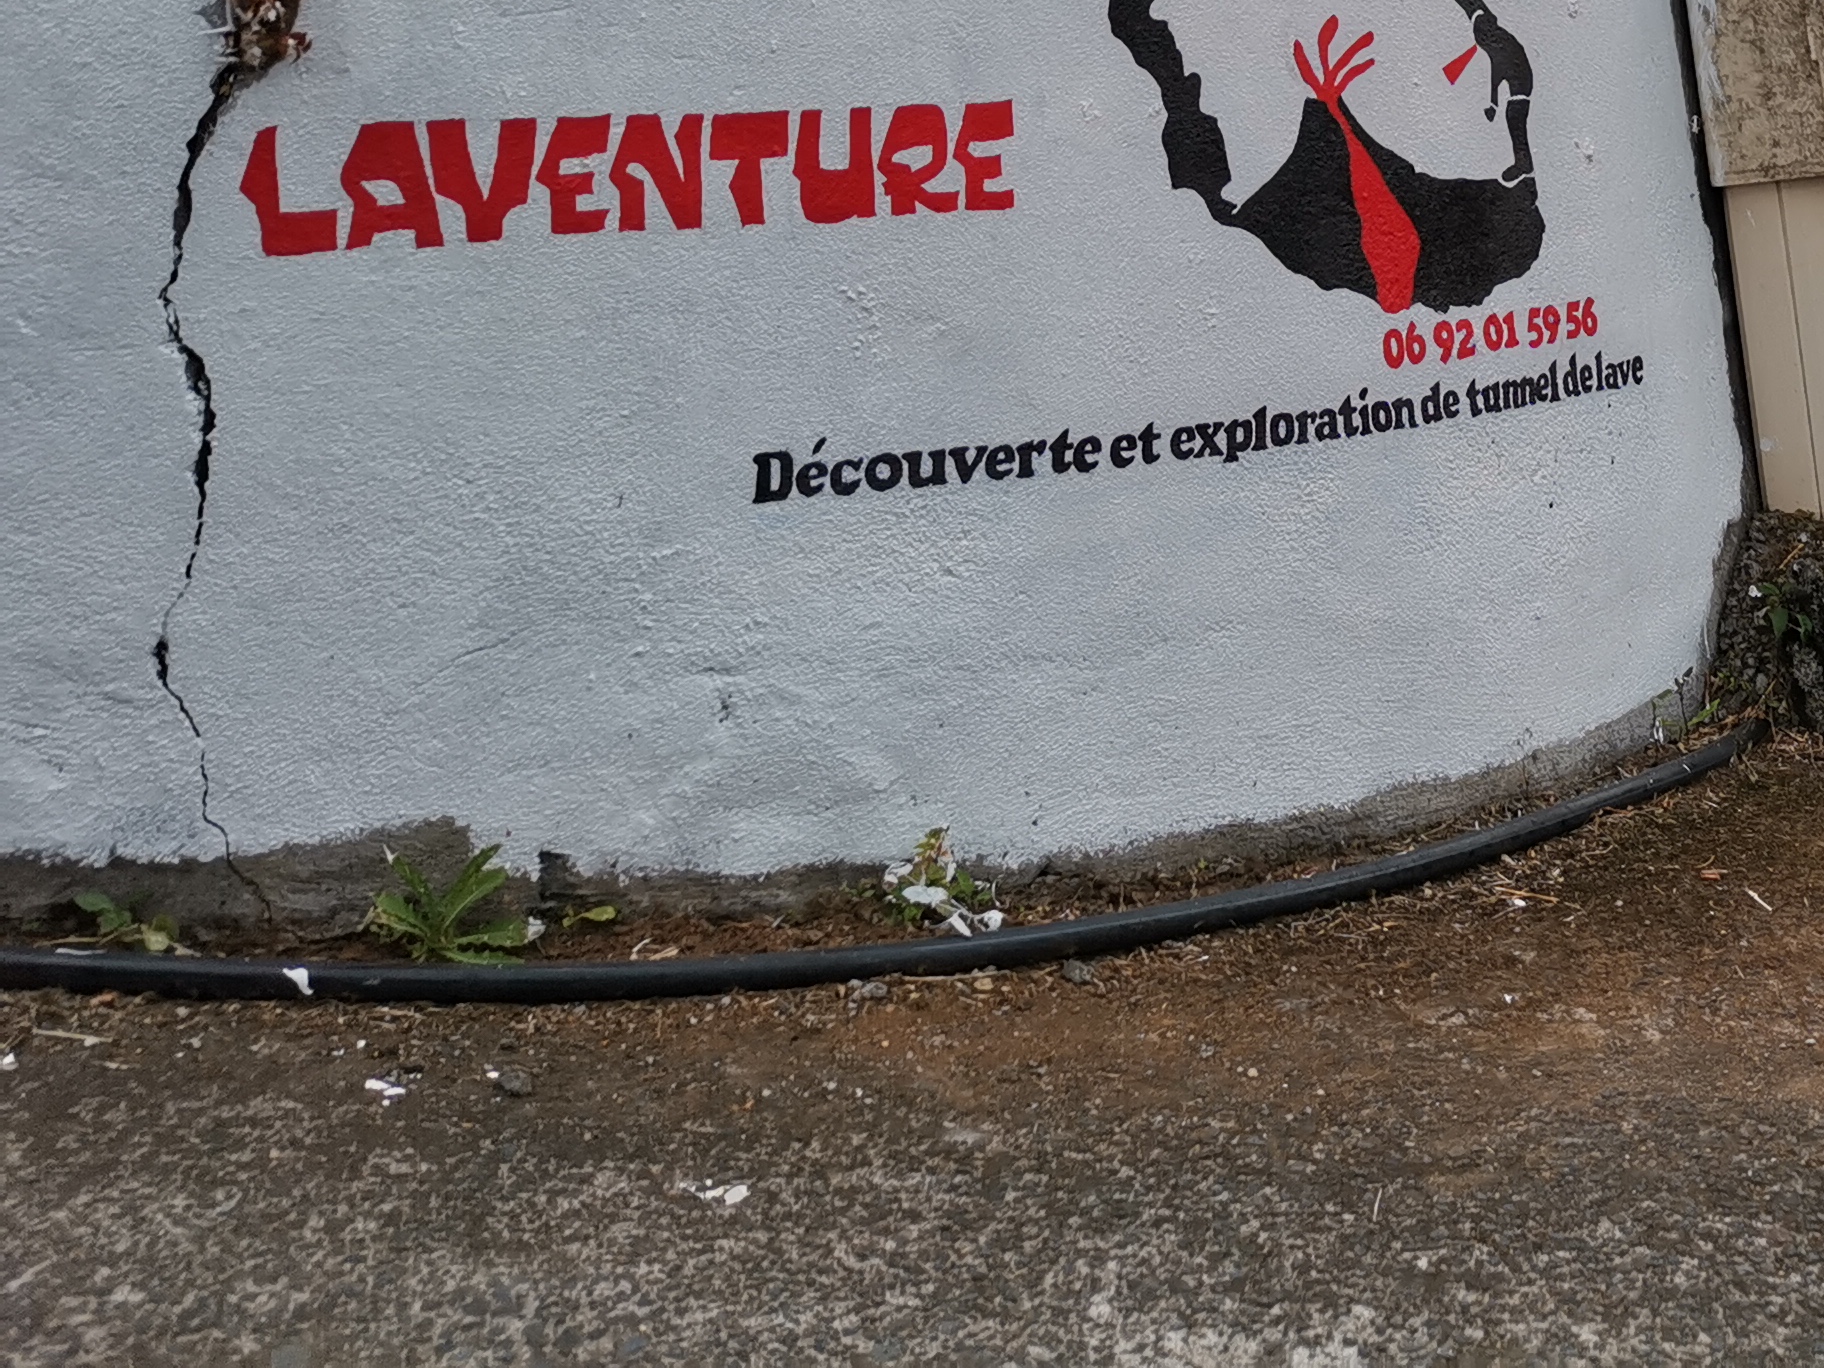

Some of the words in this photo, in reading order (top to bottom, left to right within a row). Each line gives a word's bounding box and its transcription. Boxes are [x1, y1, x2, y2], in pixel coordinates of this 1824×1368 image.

[239, 99, 1014, 257] LAVENTURE
[1382, 321, 1427, 370] 06
[1433, 319, 1477, 365] 92
[1482, 310, 1520, 352] 01
[1527, 304, 1561, 349] 59
[1566, 297, 1598, 340] 56
[752, 427, 1102, 505] Découverte
[1109, 421, 1162, 470] et
[1169, 386, 1420, 464] exploration
[1420, 380, 1461, 425] de
[1465, 358, 1561, 419] tunnel
